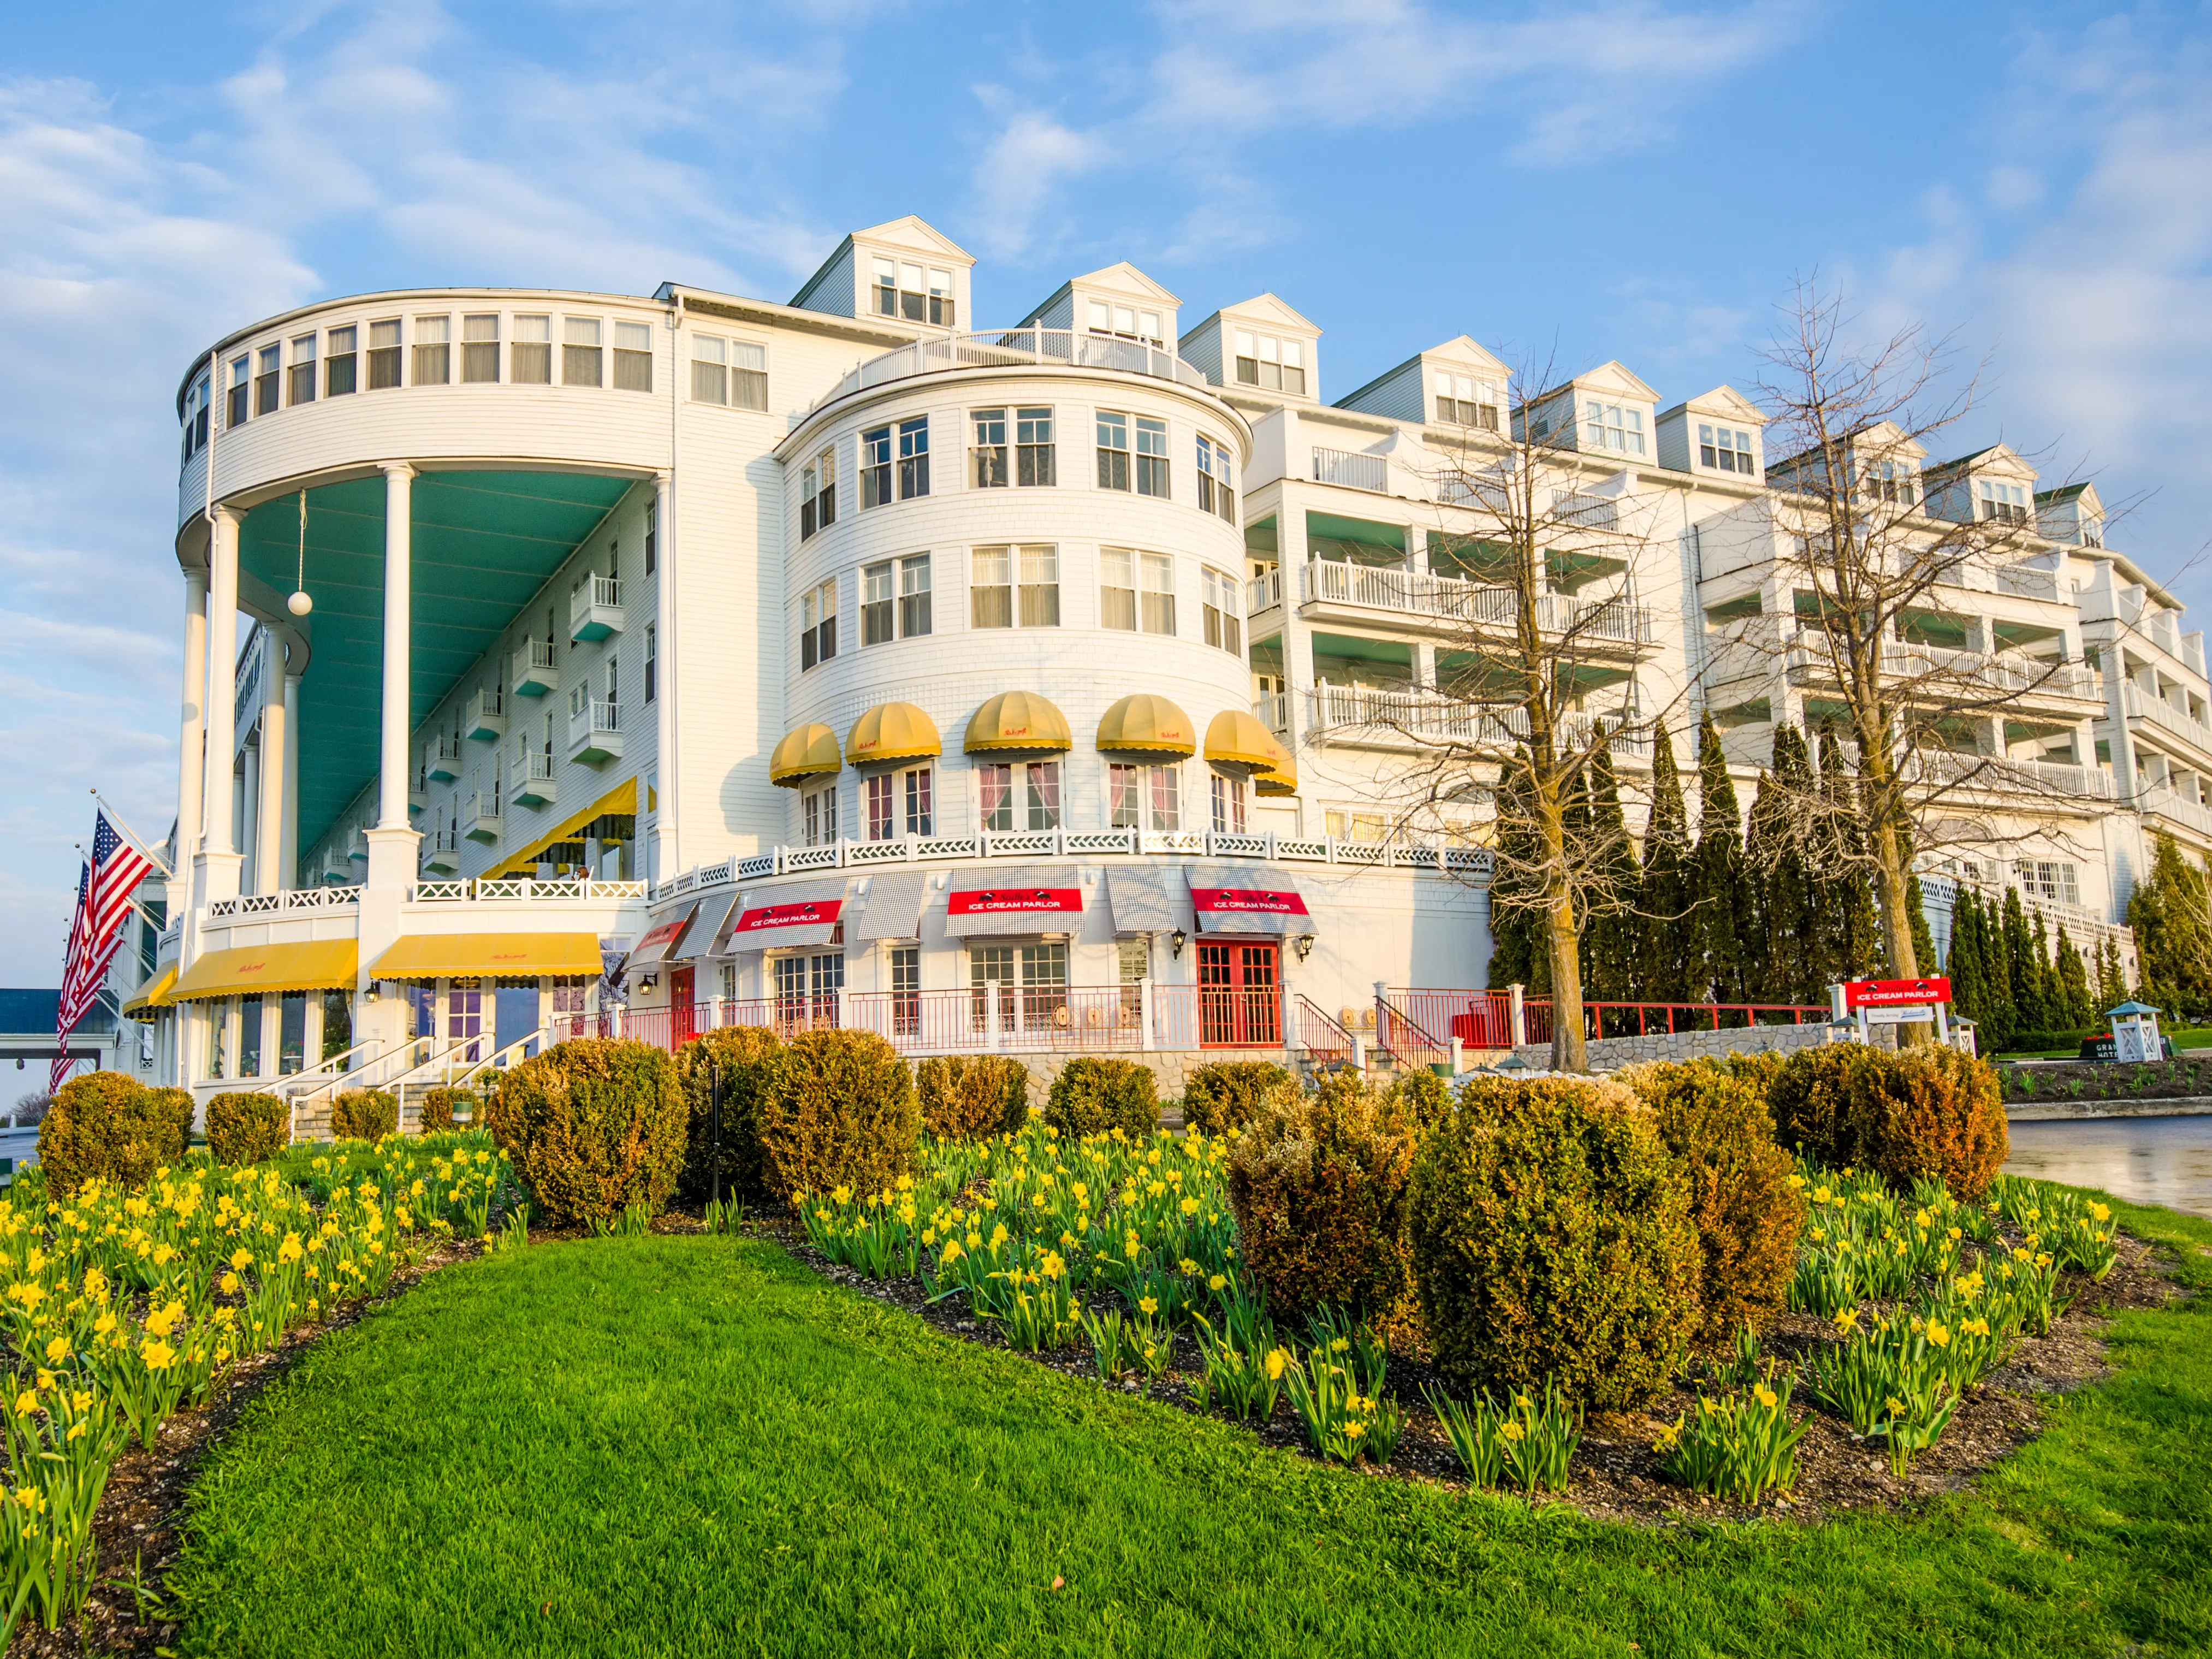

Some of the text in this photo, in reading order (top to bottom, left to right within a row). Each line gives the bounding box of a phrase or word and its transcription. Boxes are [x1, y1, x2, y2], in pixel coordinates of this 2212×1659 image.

[999, 892, 1030, 901] Sadie's
[763, 917, 788, 925] CREAM
[1884, 984, 1911, 992] Sadie's
